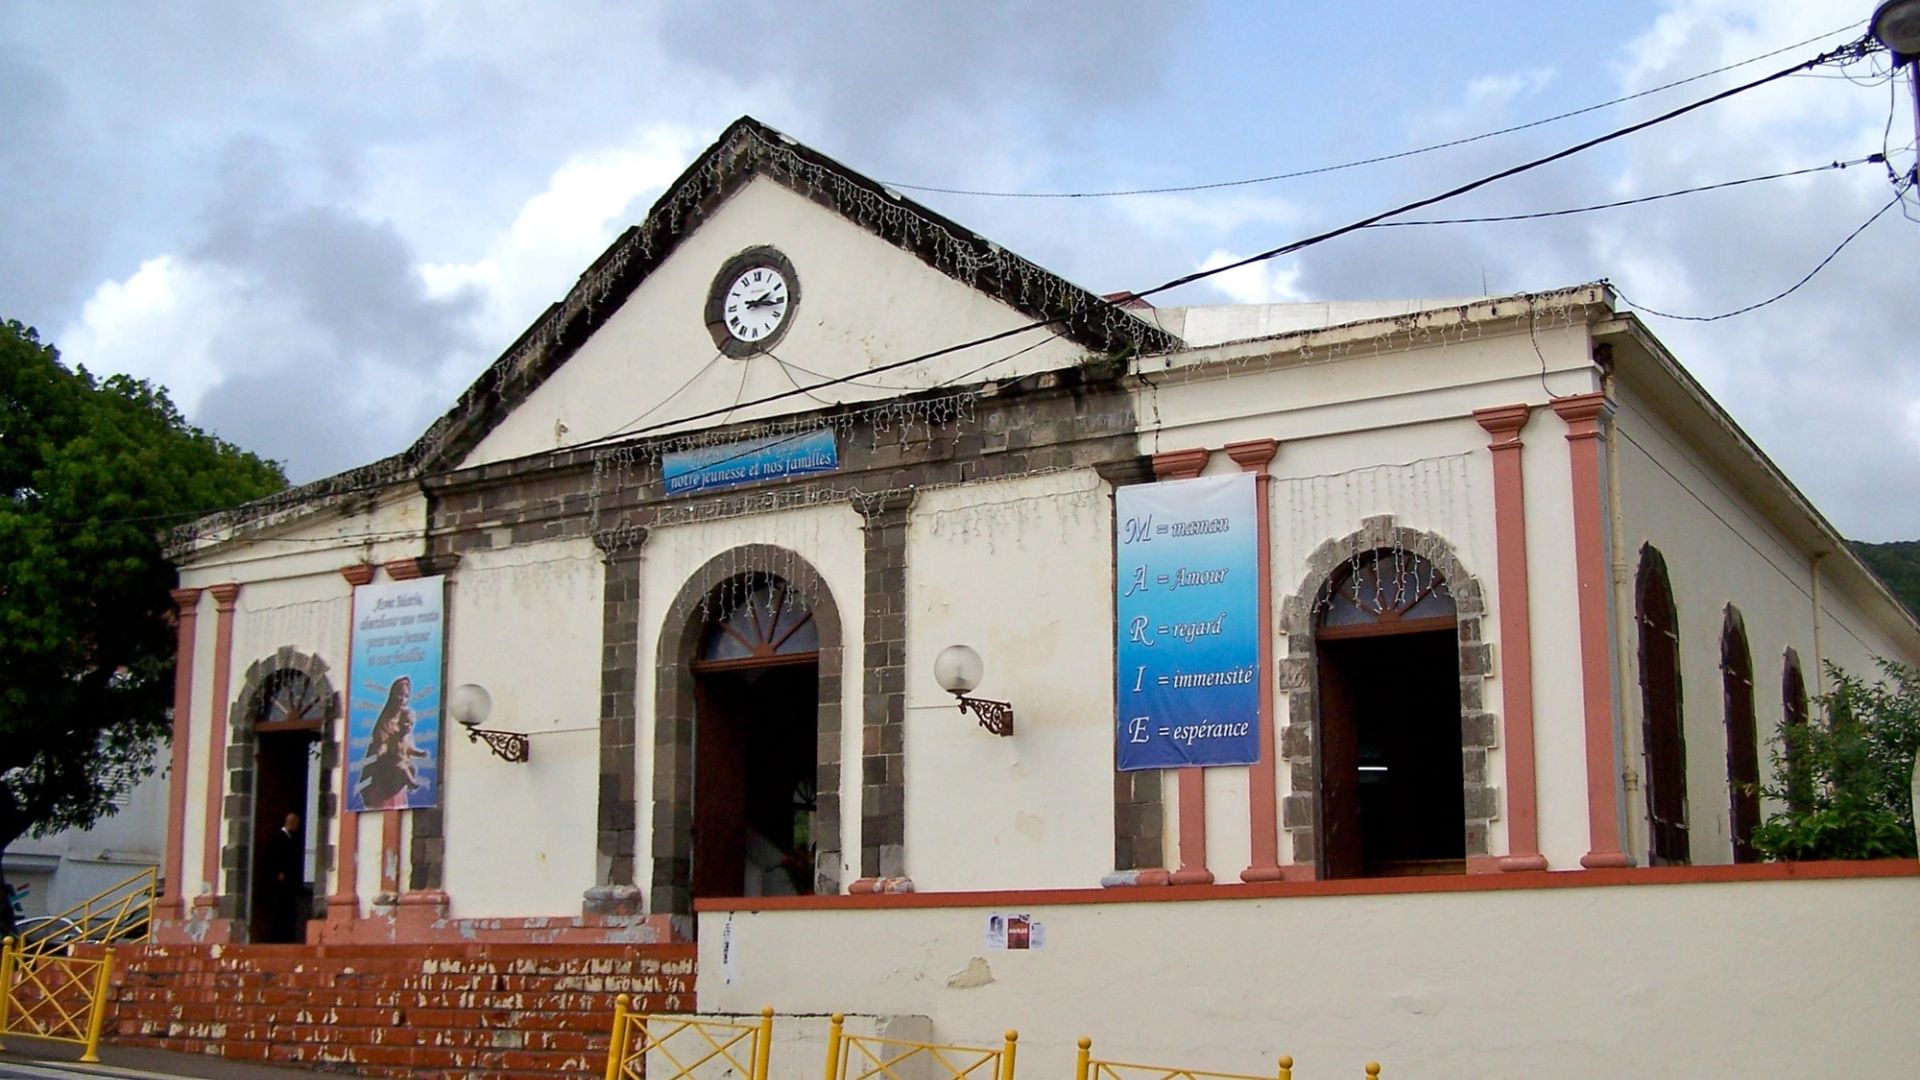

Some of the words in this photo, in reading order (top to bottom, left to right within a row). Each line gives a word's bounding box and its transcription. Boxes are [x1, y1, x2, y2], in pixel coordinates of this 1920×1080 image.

[671, 476, 700, 489] notre
[701, 466, 746, 487] jeunesse
[748, 464, 759, 476] et
[763, 459, 783, 474] nos
[785, 450, 832, 473] familles
[1124, 514, 1152, 544] M
[1171, 517, 1230, 537] maman
[1124, 564, 1148, 597] A
[1169, 567, 1229, 591] Amour
[1130, 615, 1155, 647] R
[1173, 612, 1227, 643] regard
[1132, 665, 1147, 693] I
[1173, 665, 1253, 689] immensité
[1128, 716, 1149, 744] E
[1173, 719, 1249, 745] espérance
